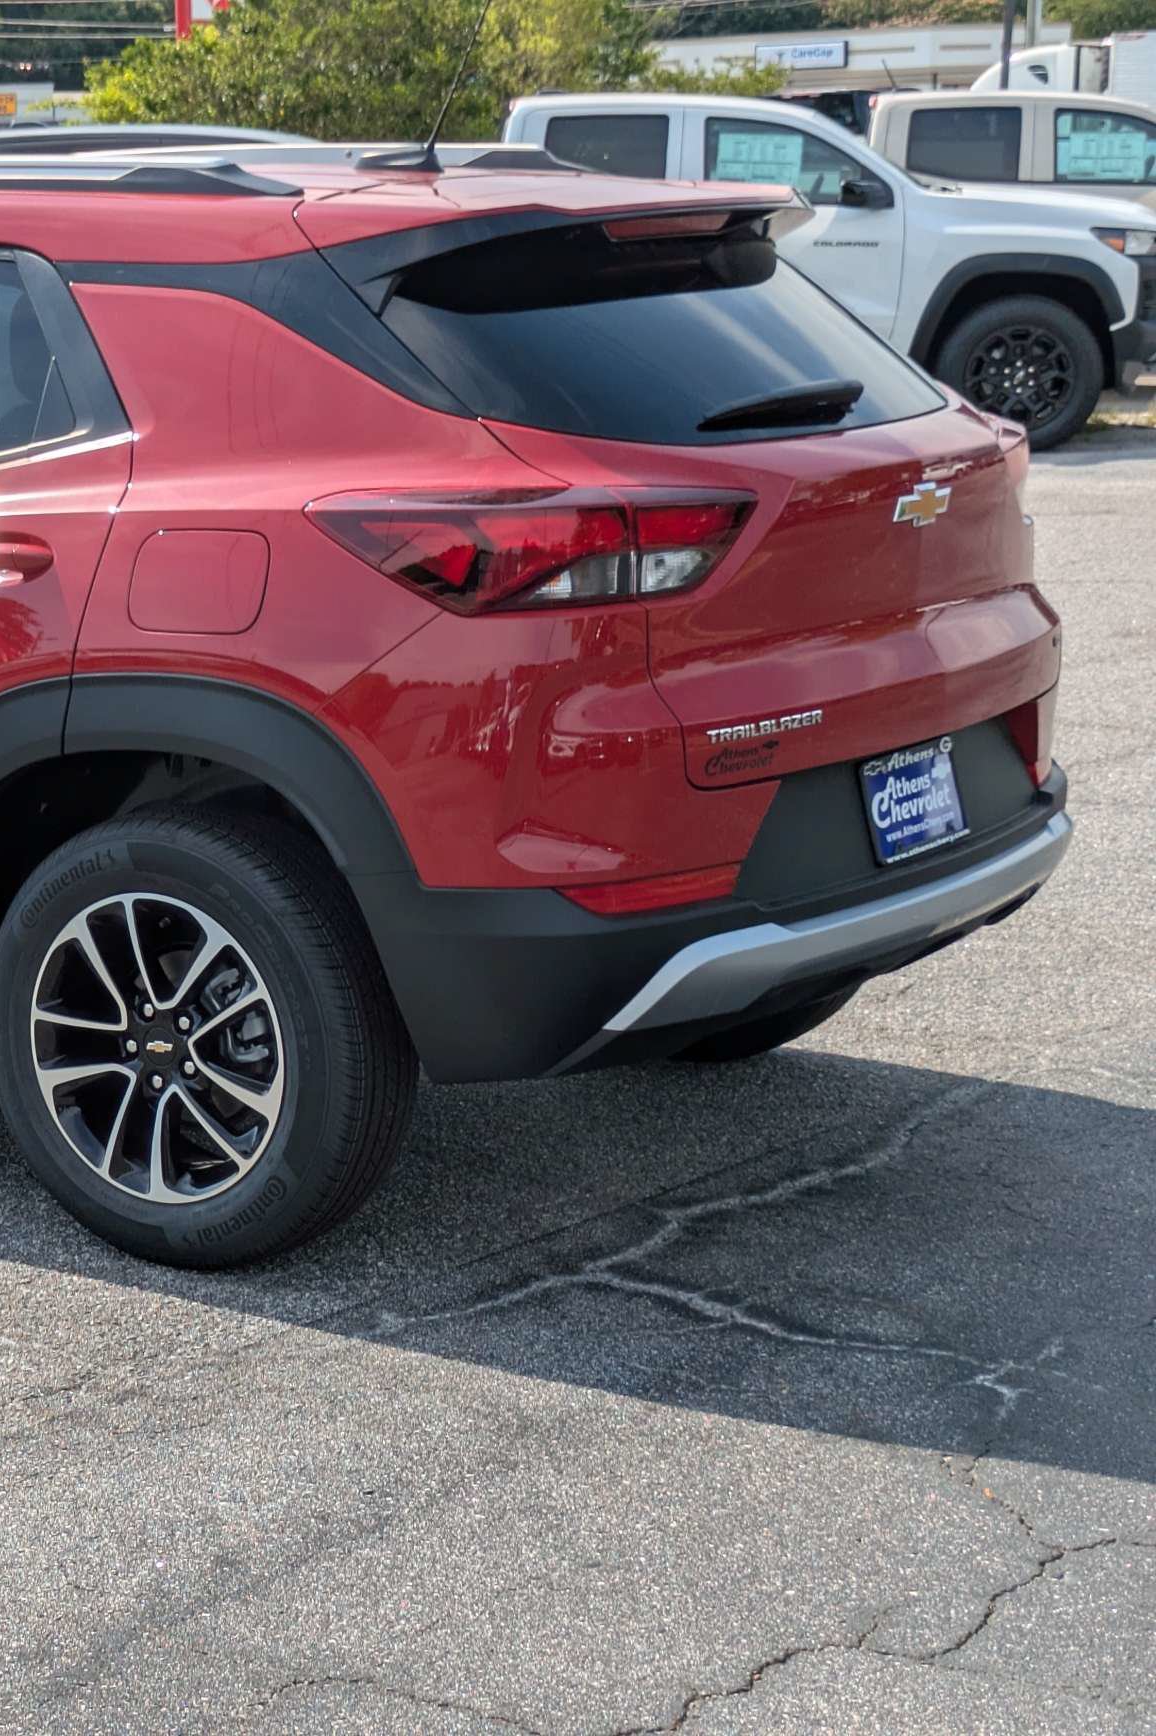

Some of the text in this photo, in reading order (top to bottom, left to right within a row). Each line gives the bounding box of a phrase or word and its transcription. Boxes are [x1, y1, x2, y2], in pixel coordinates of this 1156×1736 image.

[812, 240, 880, 249] COLORADO
[706, 709, 823, 744] TRAILBLAZER
[704, 751, 774, 777] Chevrolet
[720, 747, 760, 763] Athens
[886, 747, 934, 772] Athens
[884, 774, 931, 800] Athens
[871, 783, 951, 829] Chevrolet
[196, 1175, 288, 1246] Continental
